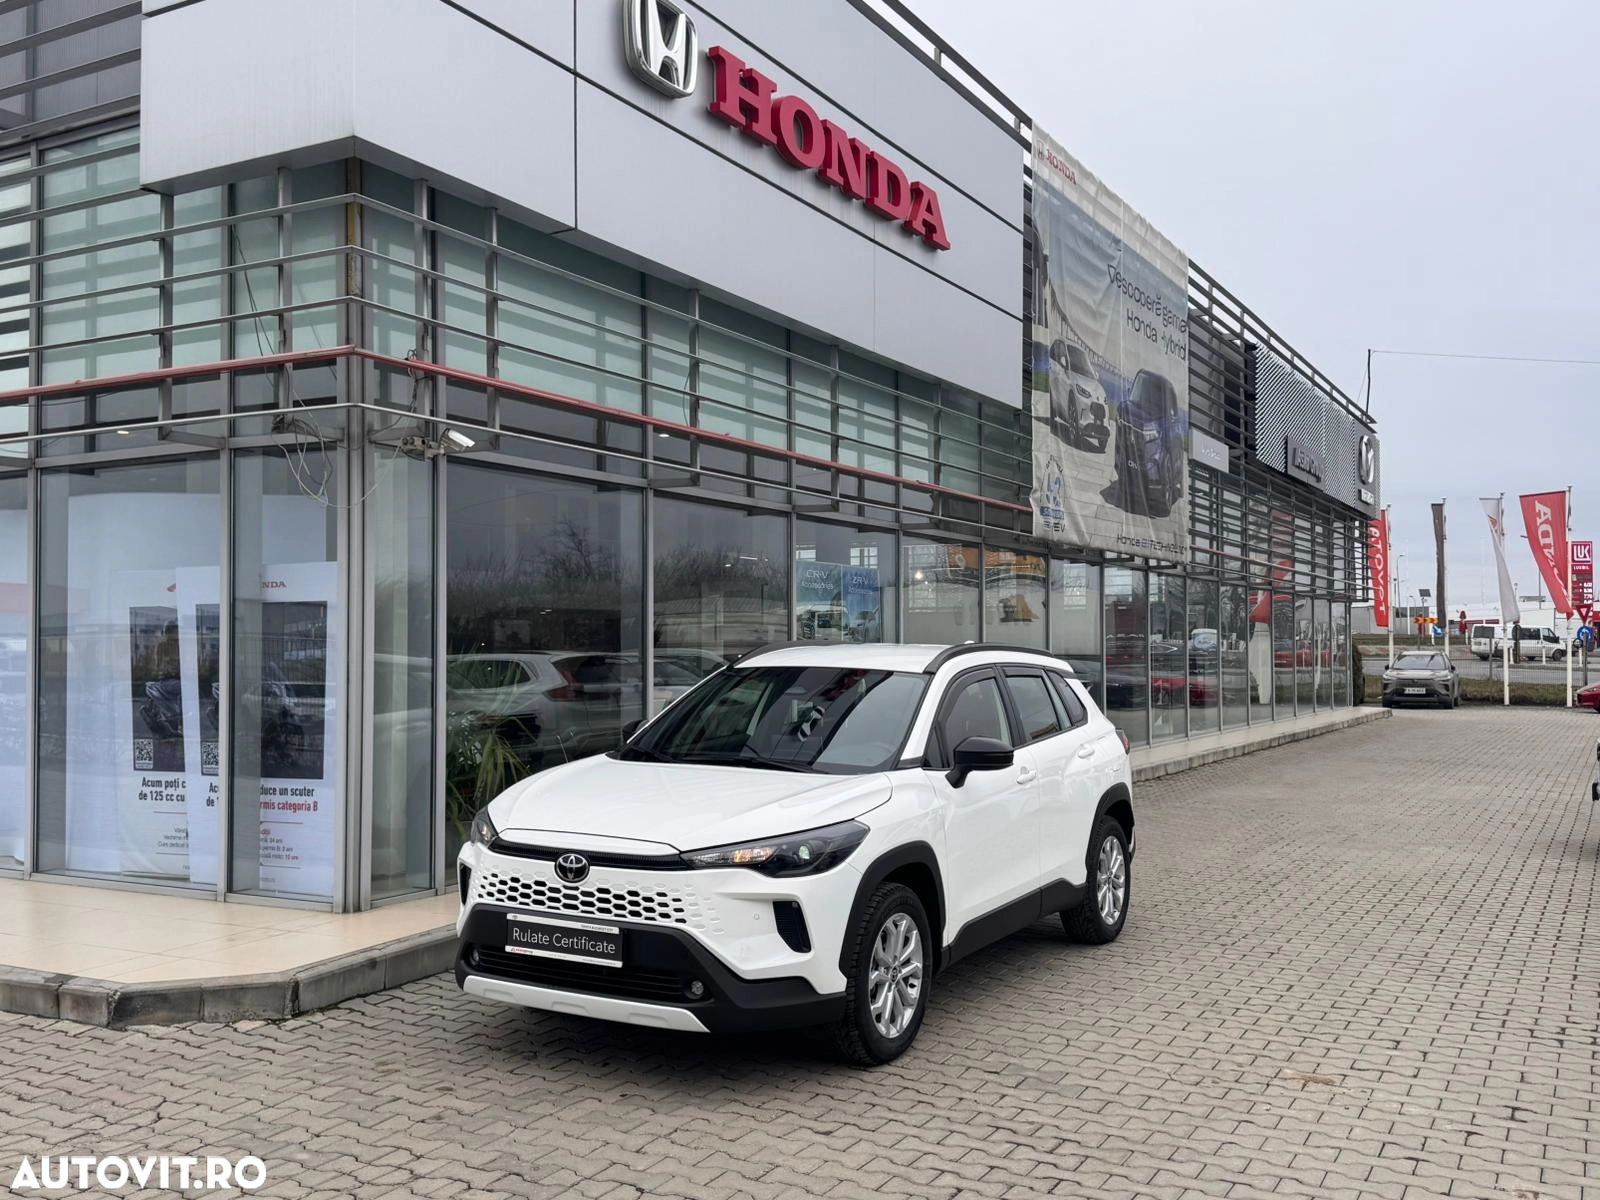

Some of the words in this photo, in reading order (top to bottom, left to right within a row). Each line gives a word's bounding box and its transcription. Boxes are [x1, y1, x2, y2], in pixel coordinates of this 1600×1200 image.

[707, 45, 951, 251] HONDA
[1046, 149, 1078, 185] HONDA
[1126, 308, 1158, 344] Honda
[806, 569, 829, 579] CR-V
[141, 776, 163, 788] Acum
[164, 777, 180, 791] poți
[138, 790, 148, 800] de
[149, 790, 163, 801] 125
[165, 793, 174, 801] cc
[176, 793, 185, 802] cu
[279, 787, 288, 796] un
[290, 786, 315, 797] scuter
[206, 795, 215, 807] de
[277, 800, 311, 814] categoria
[313, 801, 318, 812] B
[512, 927, 550, 945] Rulate
[552, 933, 616, 954] Certificate
